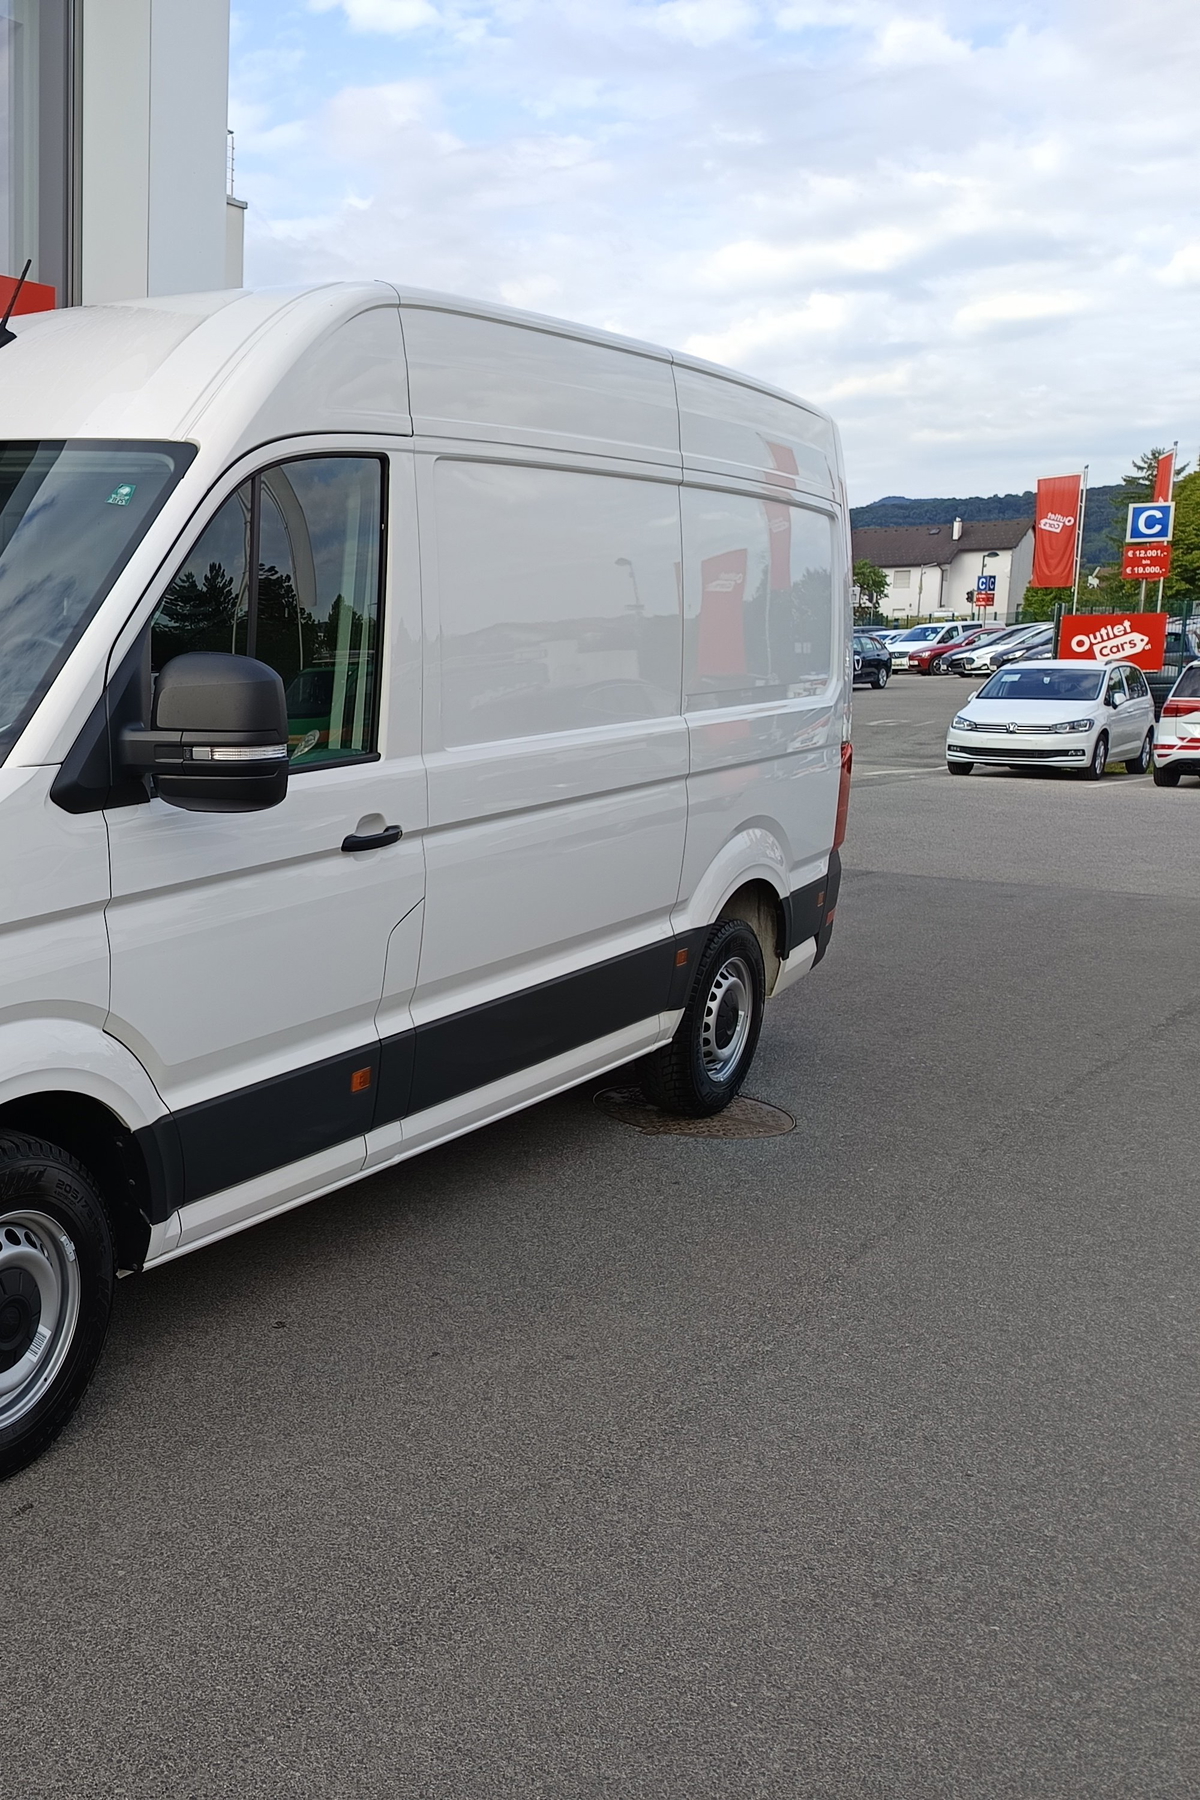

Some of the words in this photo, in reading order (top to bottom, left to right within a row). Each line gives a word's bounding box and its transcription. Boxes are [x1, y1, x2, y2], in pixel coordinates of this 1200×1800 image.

[1138, 509, 1163, 535] C
[978, 577, 986, 590] C
[989, 577, 995, 590] C
[1070, 619, 1132, 653] Outlet
[1099, 639, 1137, 657] Cars
